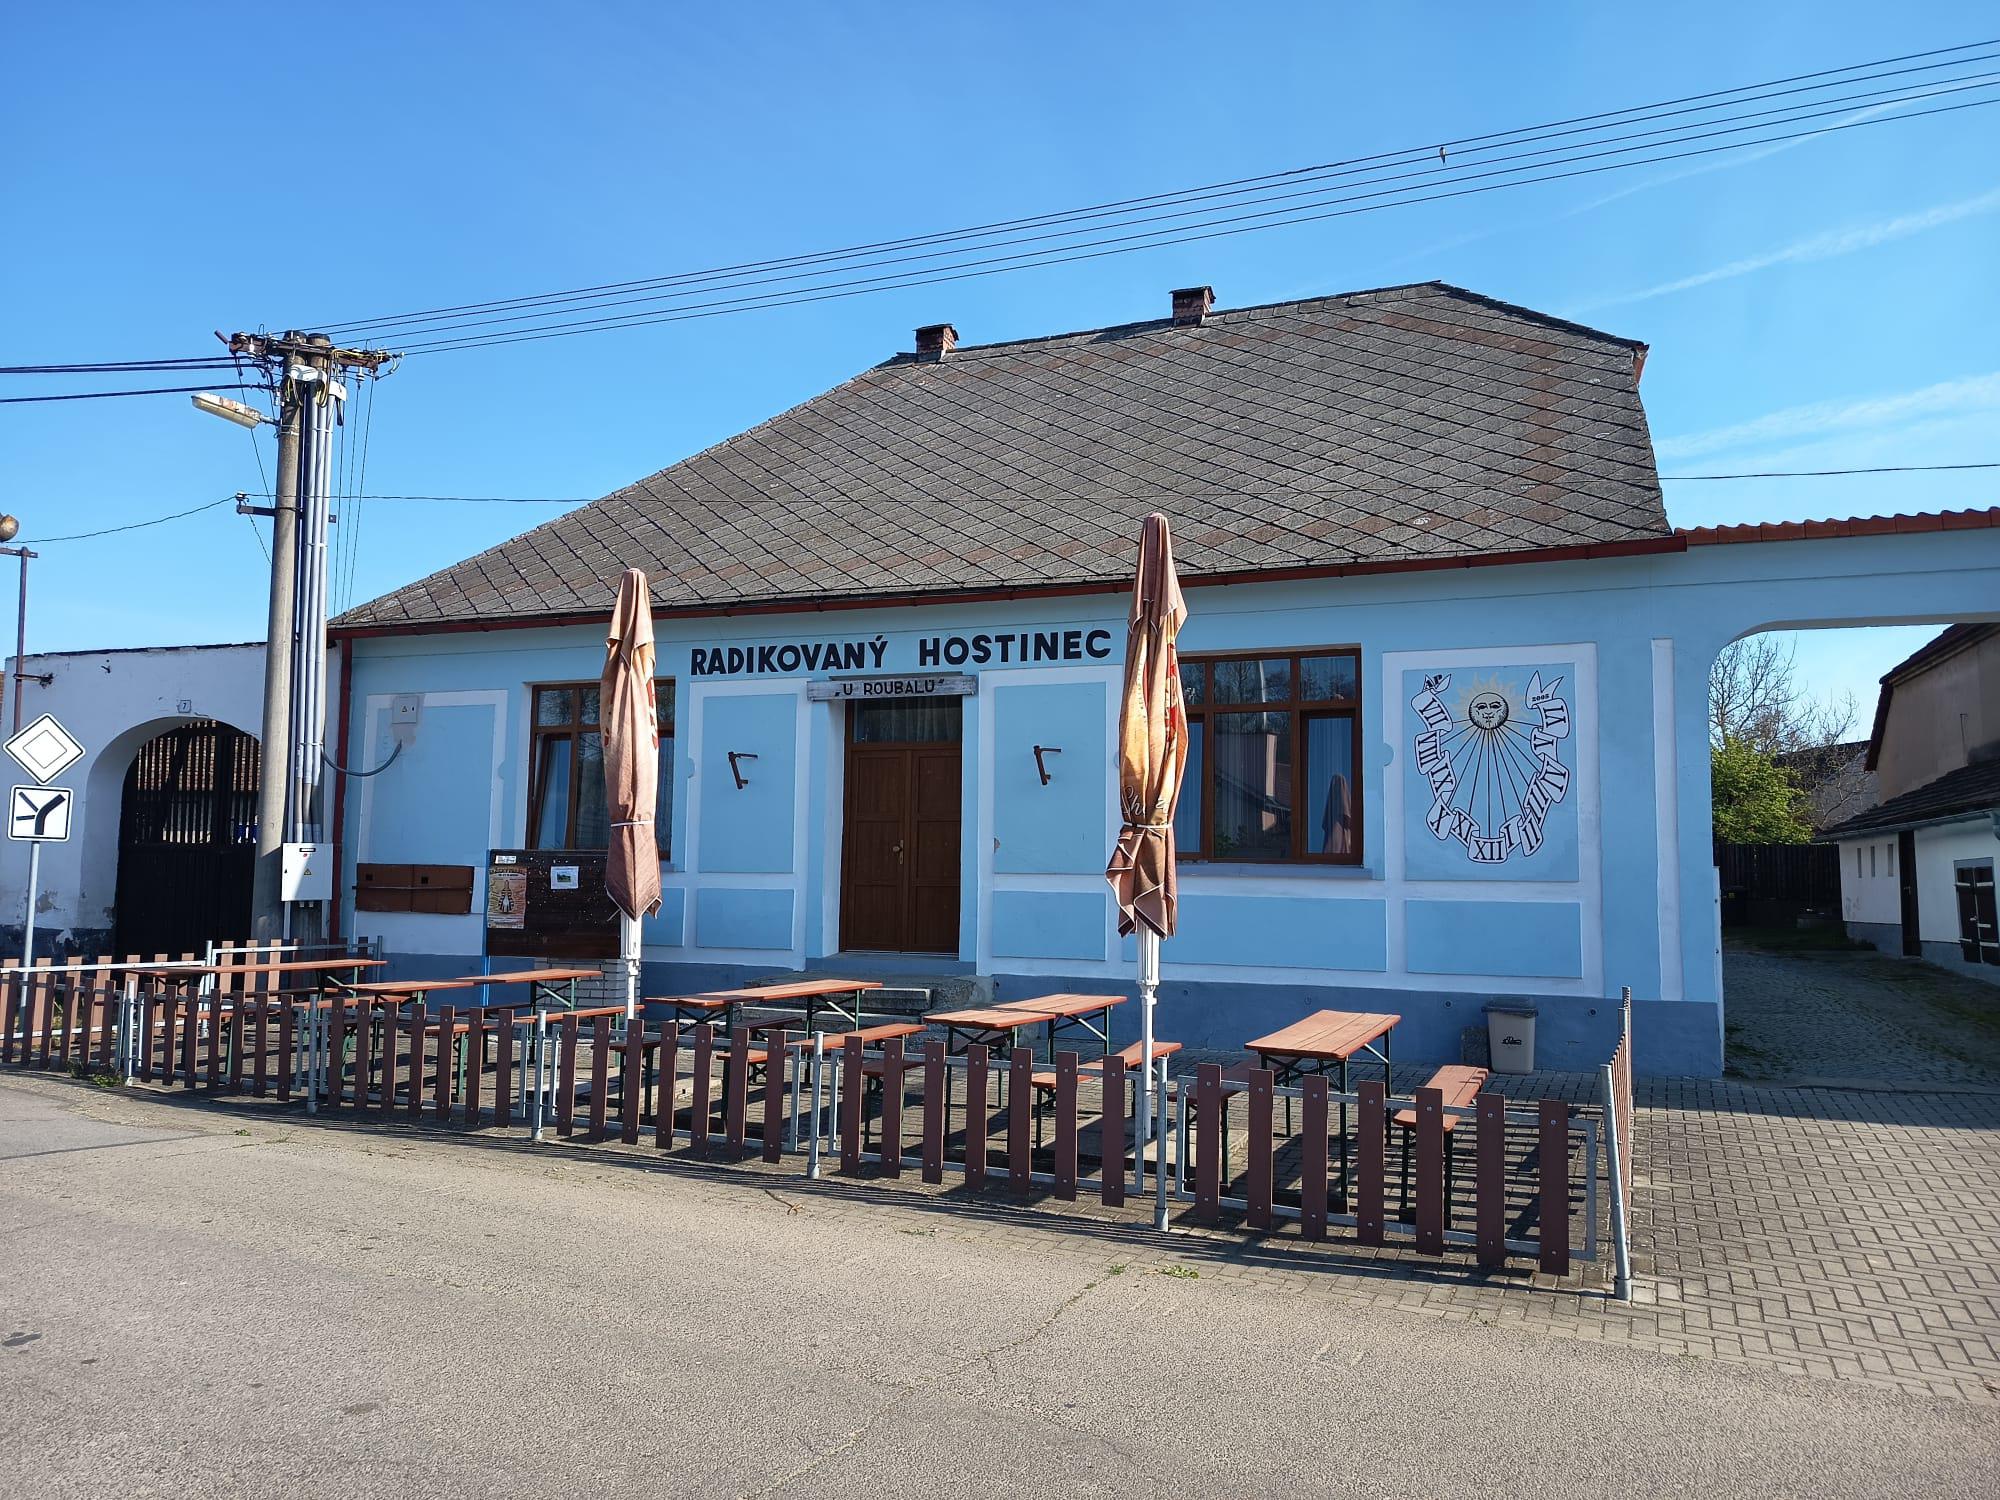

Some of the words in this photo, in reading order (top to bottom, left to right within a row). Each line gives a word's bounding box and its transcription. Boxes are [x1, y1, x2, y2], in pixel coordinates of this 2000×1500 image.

[690, 634, 889, 676] RADIKOVANÝ
[919, 629, 1112, 667] HOSTINEC
[1418, 697, 1449, 729] VII
[1542, 705, 1567, 728] VI
[1533, 734, 1554, 751] V
[1429, 804, 1451, 833] X
[1472, 840, 1505, 861] XII
